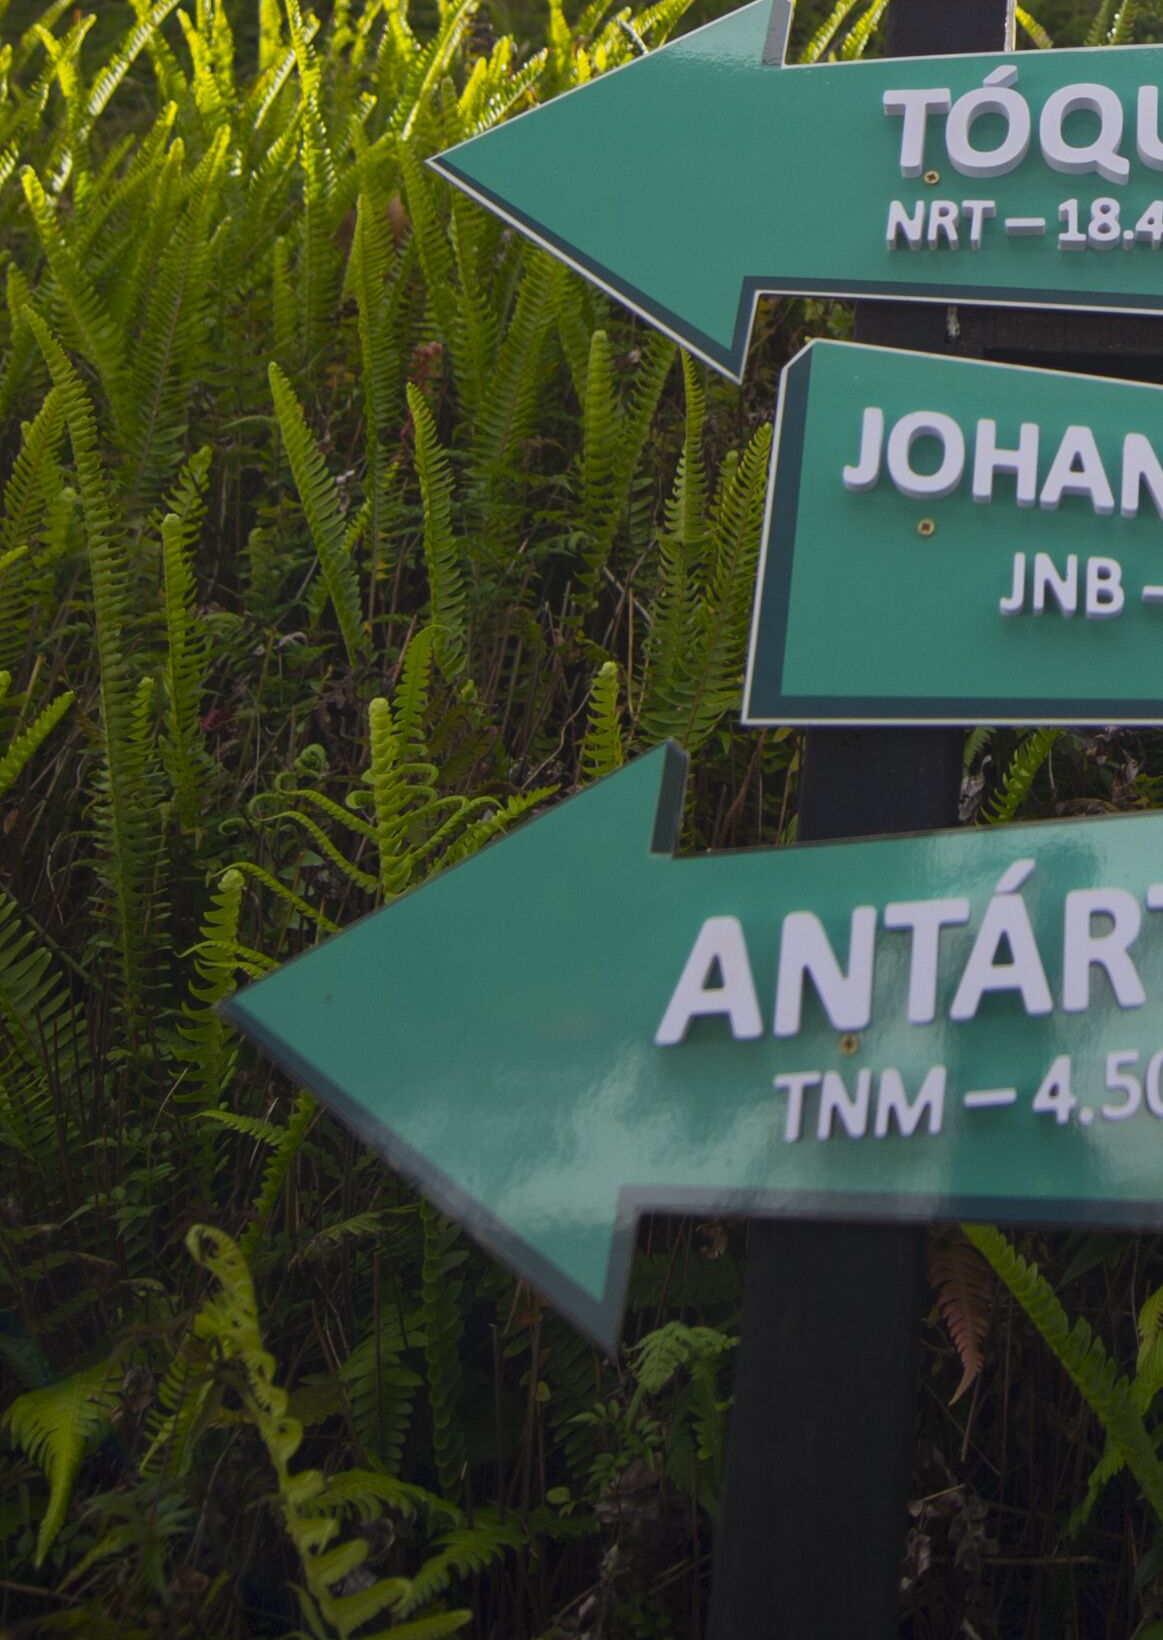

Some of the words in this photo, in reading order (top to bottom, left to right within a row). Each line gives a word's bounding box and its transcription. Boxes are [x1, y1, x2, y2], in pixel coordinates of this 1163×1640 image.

[886, 199, 996, 251] NRT
[1000, 551, 1125, 619] JNB
[773, 1066, 947, 1142] TNM
